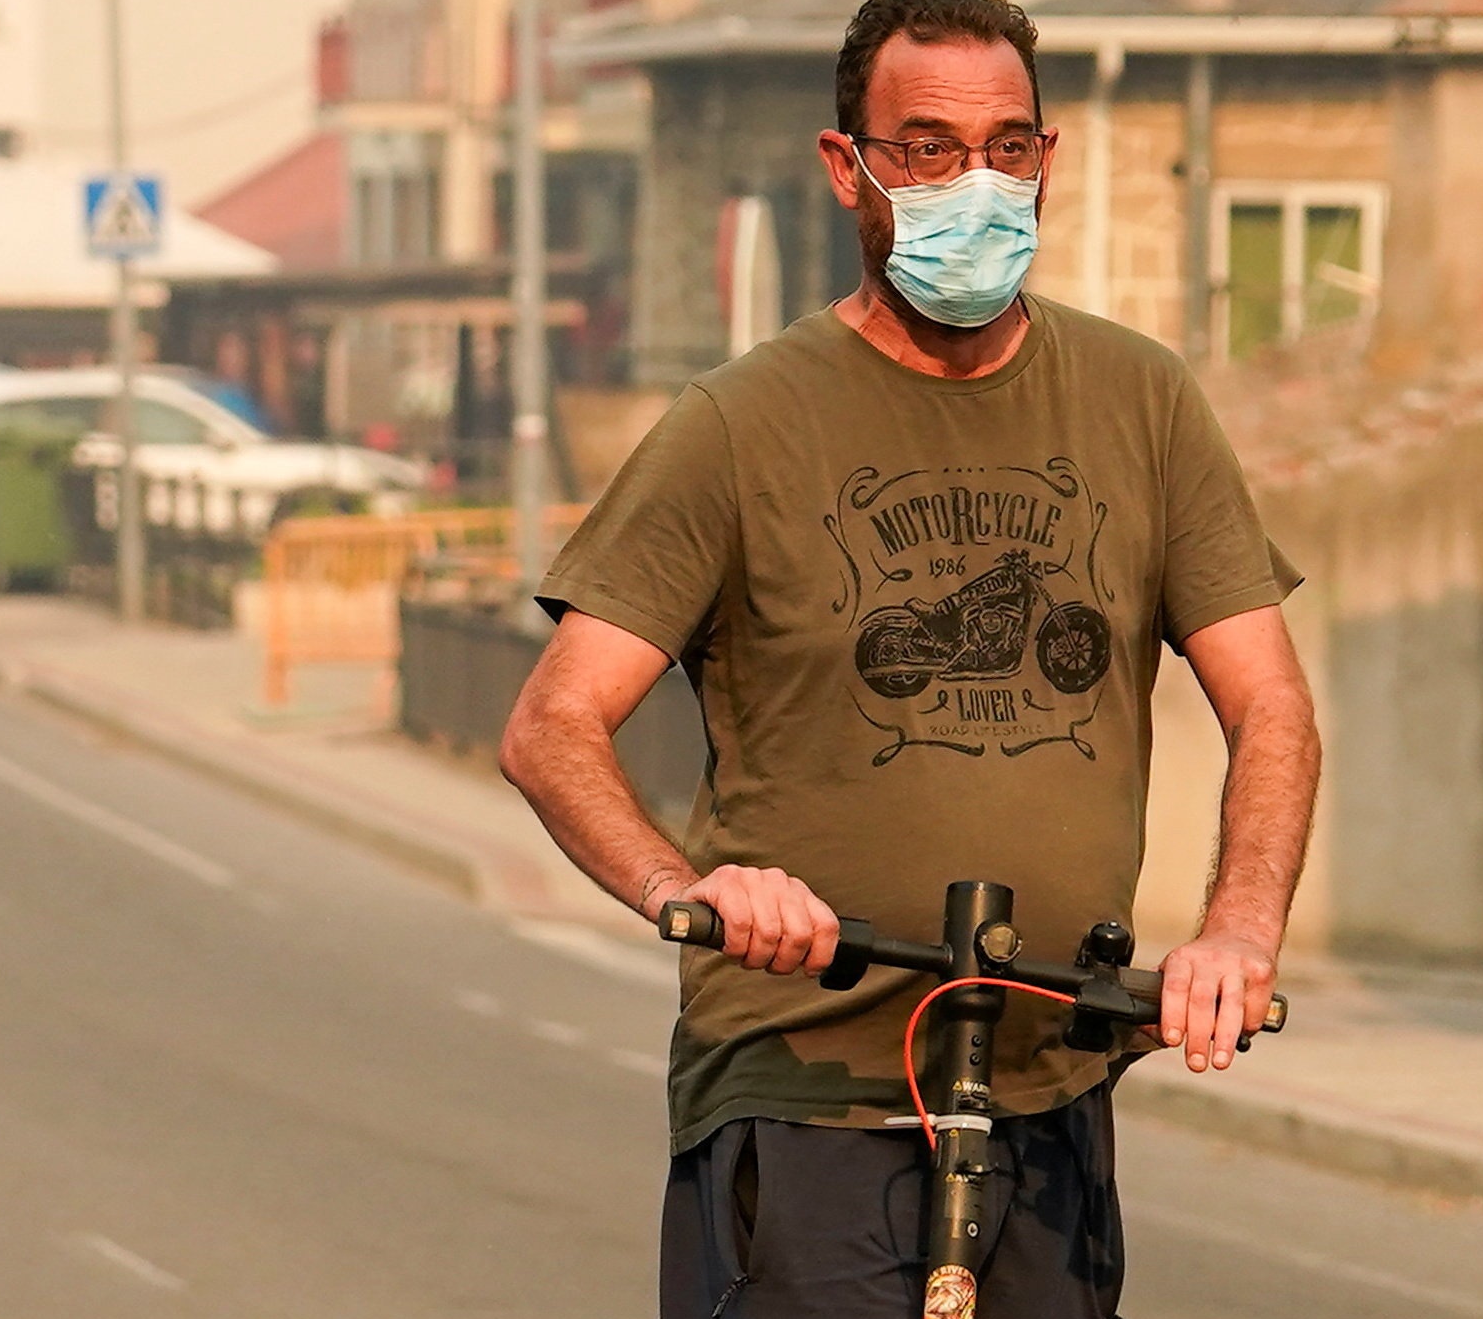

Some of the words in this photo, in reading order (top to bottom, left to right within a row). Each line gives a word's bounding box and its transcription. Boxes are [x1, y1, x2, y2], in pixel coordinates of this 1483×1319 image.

[869, 486, 1062, 557] MOTORCYCLE
[930, 555, 966, 578] 1986
[956, 688, 1017, 722] LOVER
